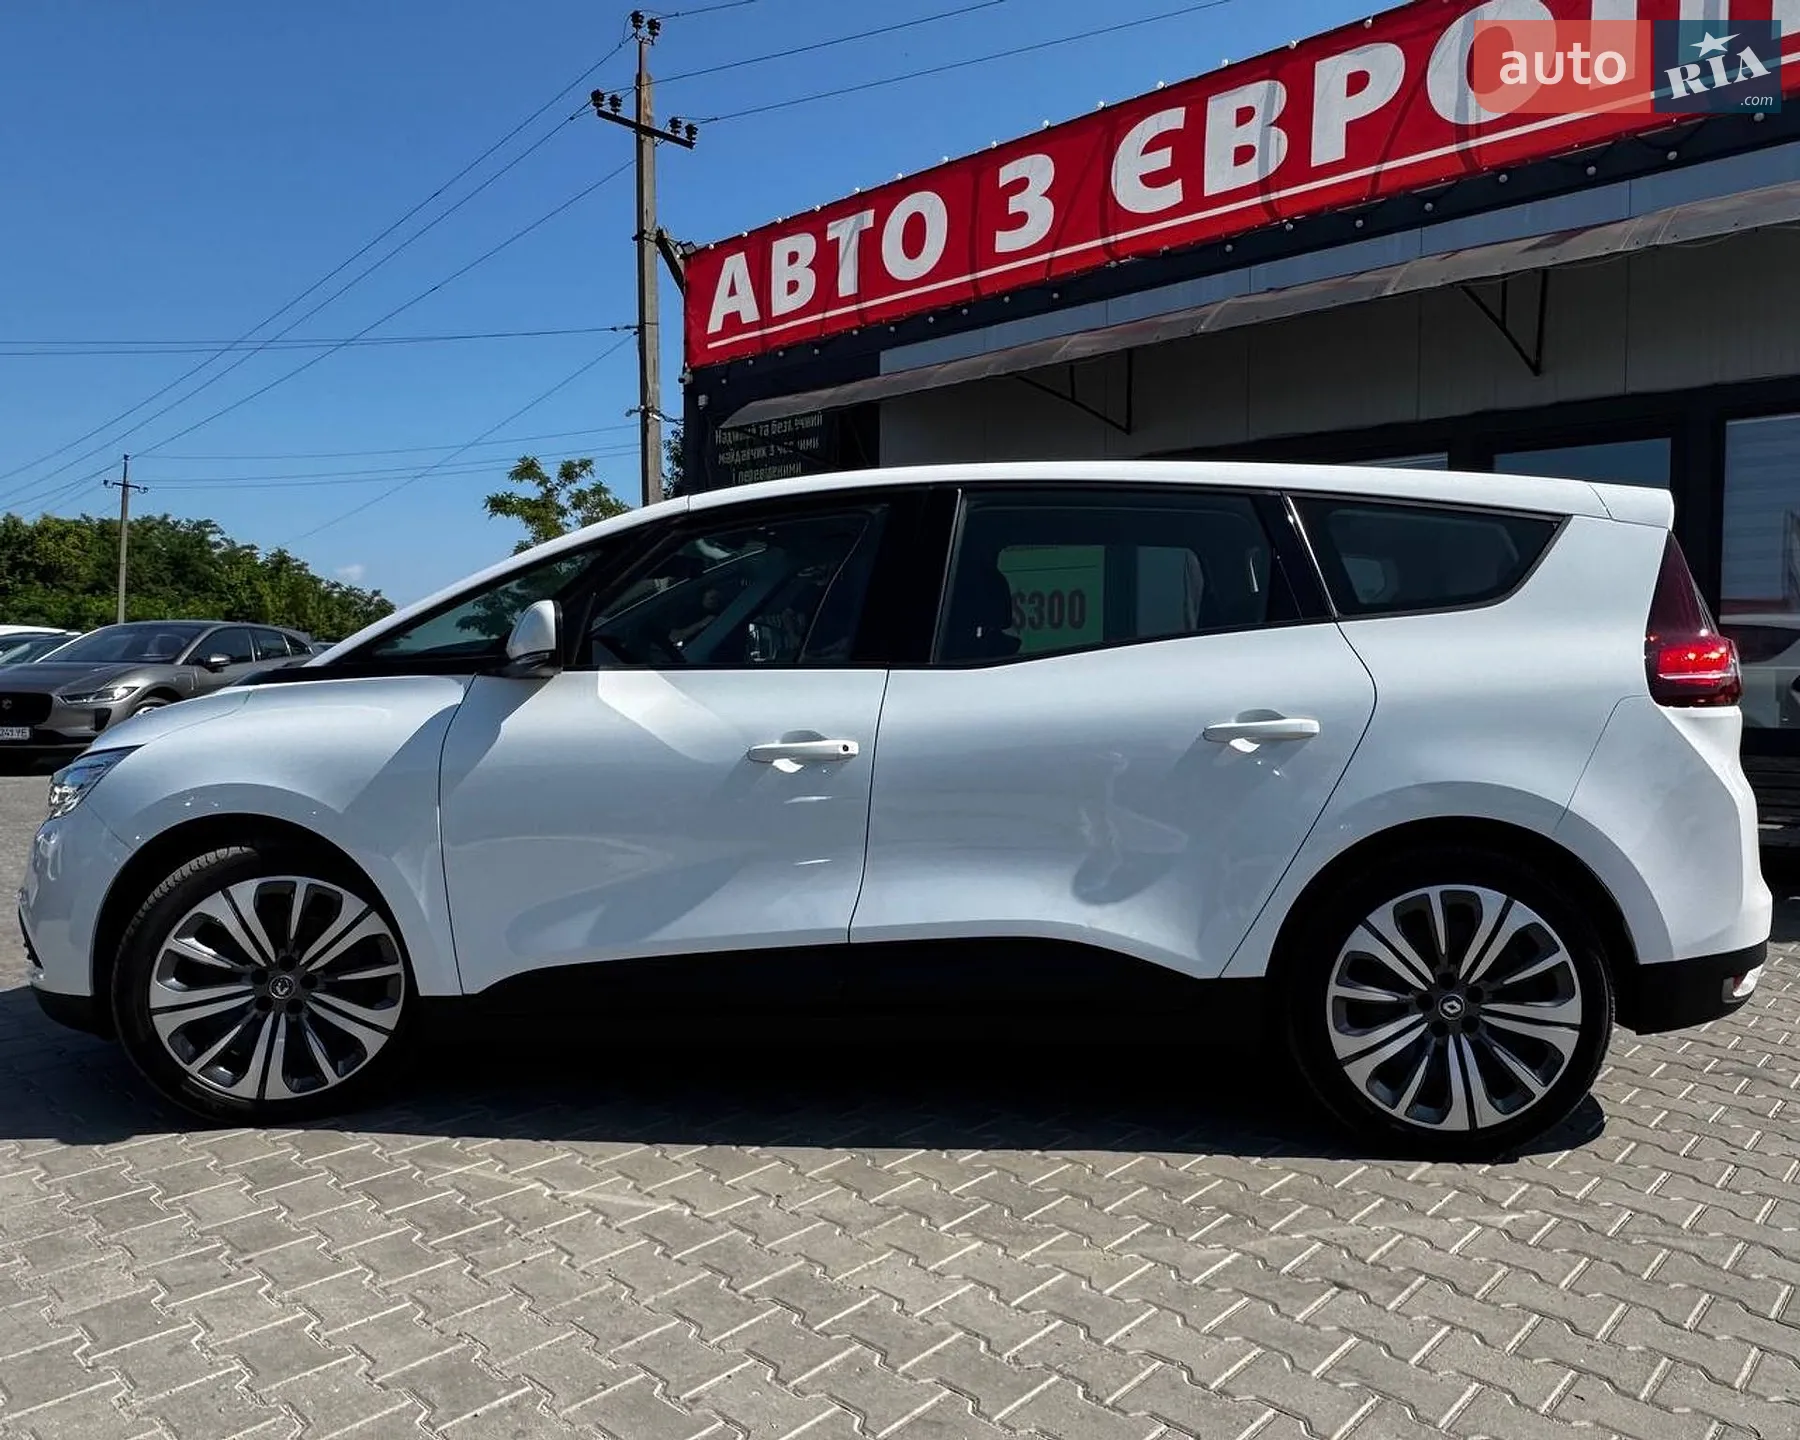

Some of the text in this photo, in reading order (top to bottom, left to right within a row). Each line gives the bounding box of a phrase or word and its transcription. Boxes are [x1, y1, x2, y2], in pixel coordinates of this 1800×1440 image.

[707, 0, 1800, 334] АВТО З ЄВРОП
